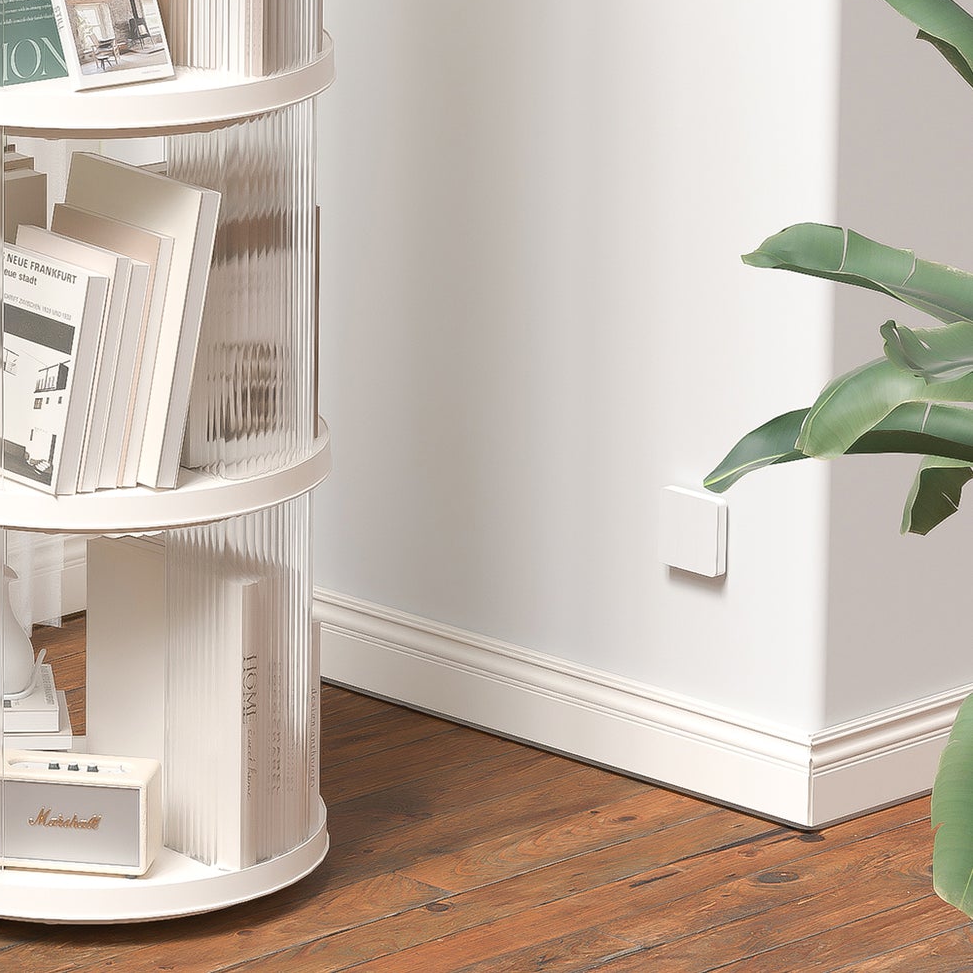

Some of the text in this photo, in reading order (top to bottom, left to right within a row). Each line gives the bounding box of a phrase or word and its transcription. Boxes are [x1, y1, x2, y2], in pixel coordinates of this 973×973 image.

[54, 5, 65, 30] STILL
[4, 268, 37, 286] eue stadt
[6, 253, 77, 285] NEUE FRANKFURT
[242, 654, 257, 724] HOME
[28, 806, 102, 831] Marshall
